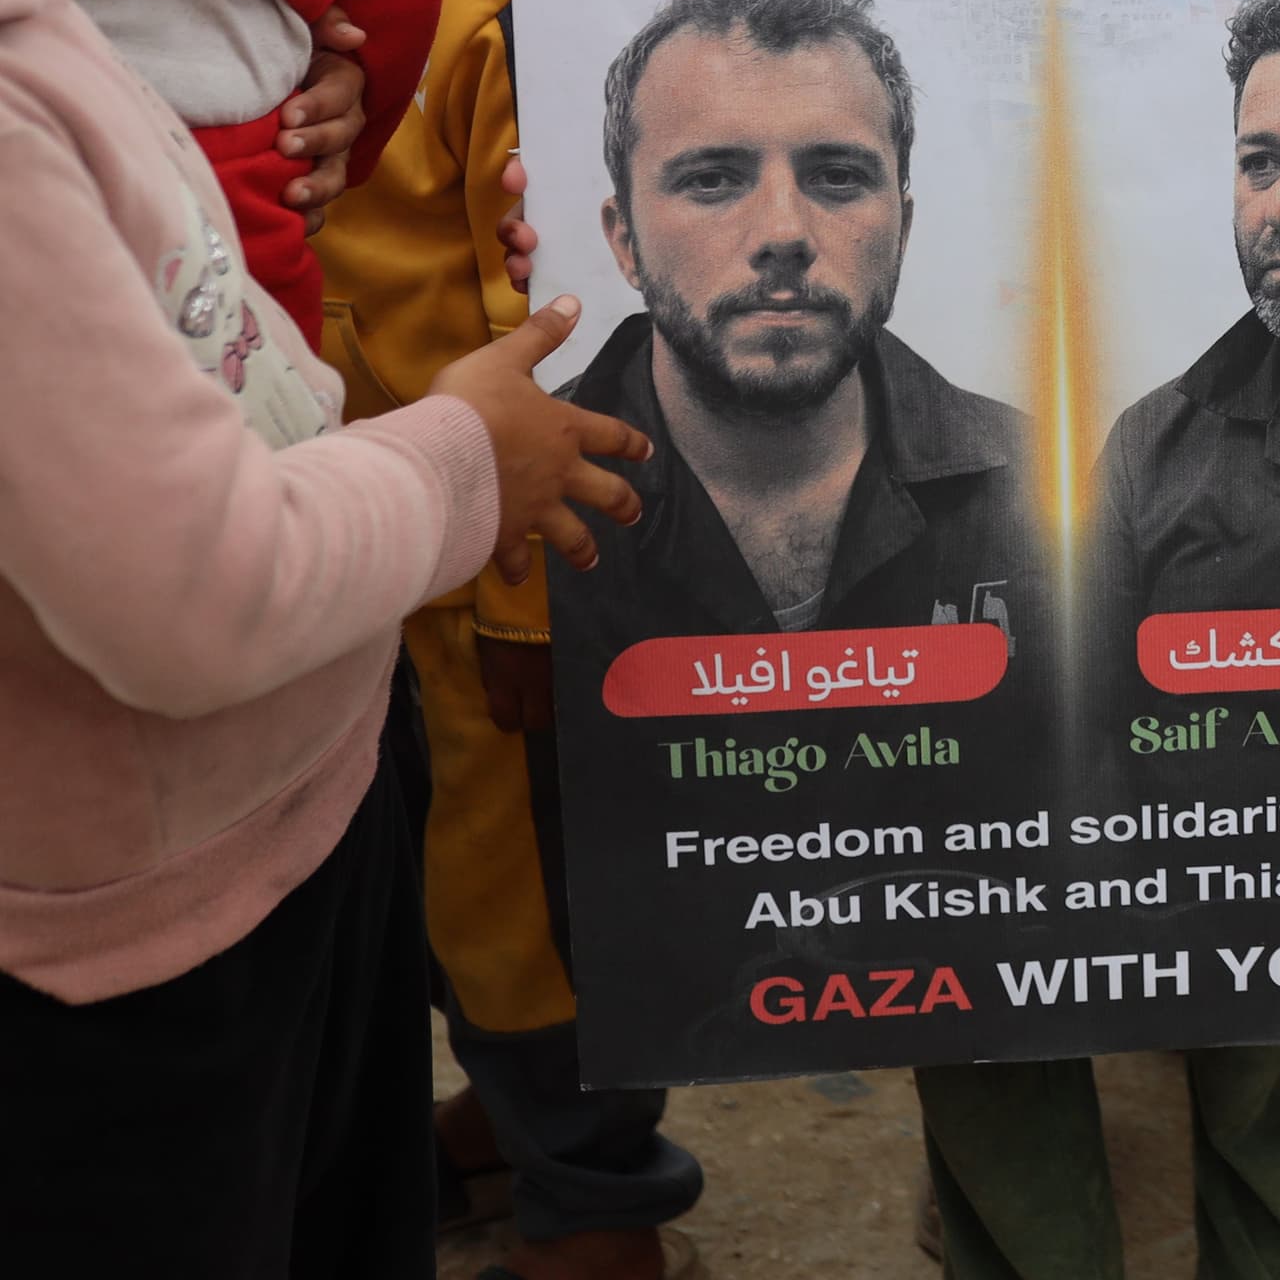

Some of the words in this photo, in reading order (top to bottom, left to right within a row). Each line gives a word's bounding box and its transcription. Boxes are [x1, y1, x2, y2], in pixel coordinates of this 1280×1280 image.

[691, 647, 791, 706] افيلا
[806, 646, 920, 702] تياغو
[657, 736, 827, 793] Thiago
[843, 726, 961, 770] Avila
[1129, 707, 1229, 754] Saif
[665, 822, 924, 868] Freedom
[943, 810, 1050, 852] and
[743, 890, 862, 930] Abu
[884, 876, 1049, 921] Kishk
[1064, 868, 1168, 911] and
[749, 966, 974, 1025] GAZA
[995, 950, 1191, 1007] WITH
